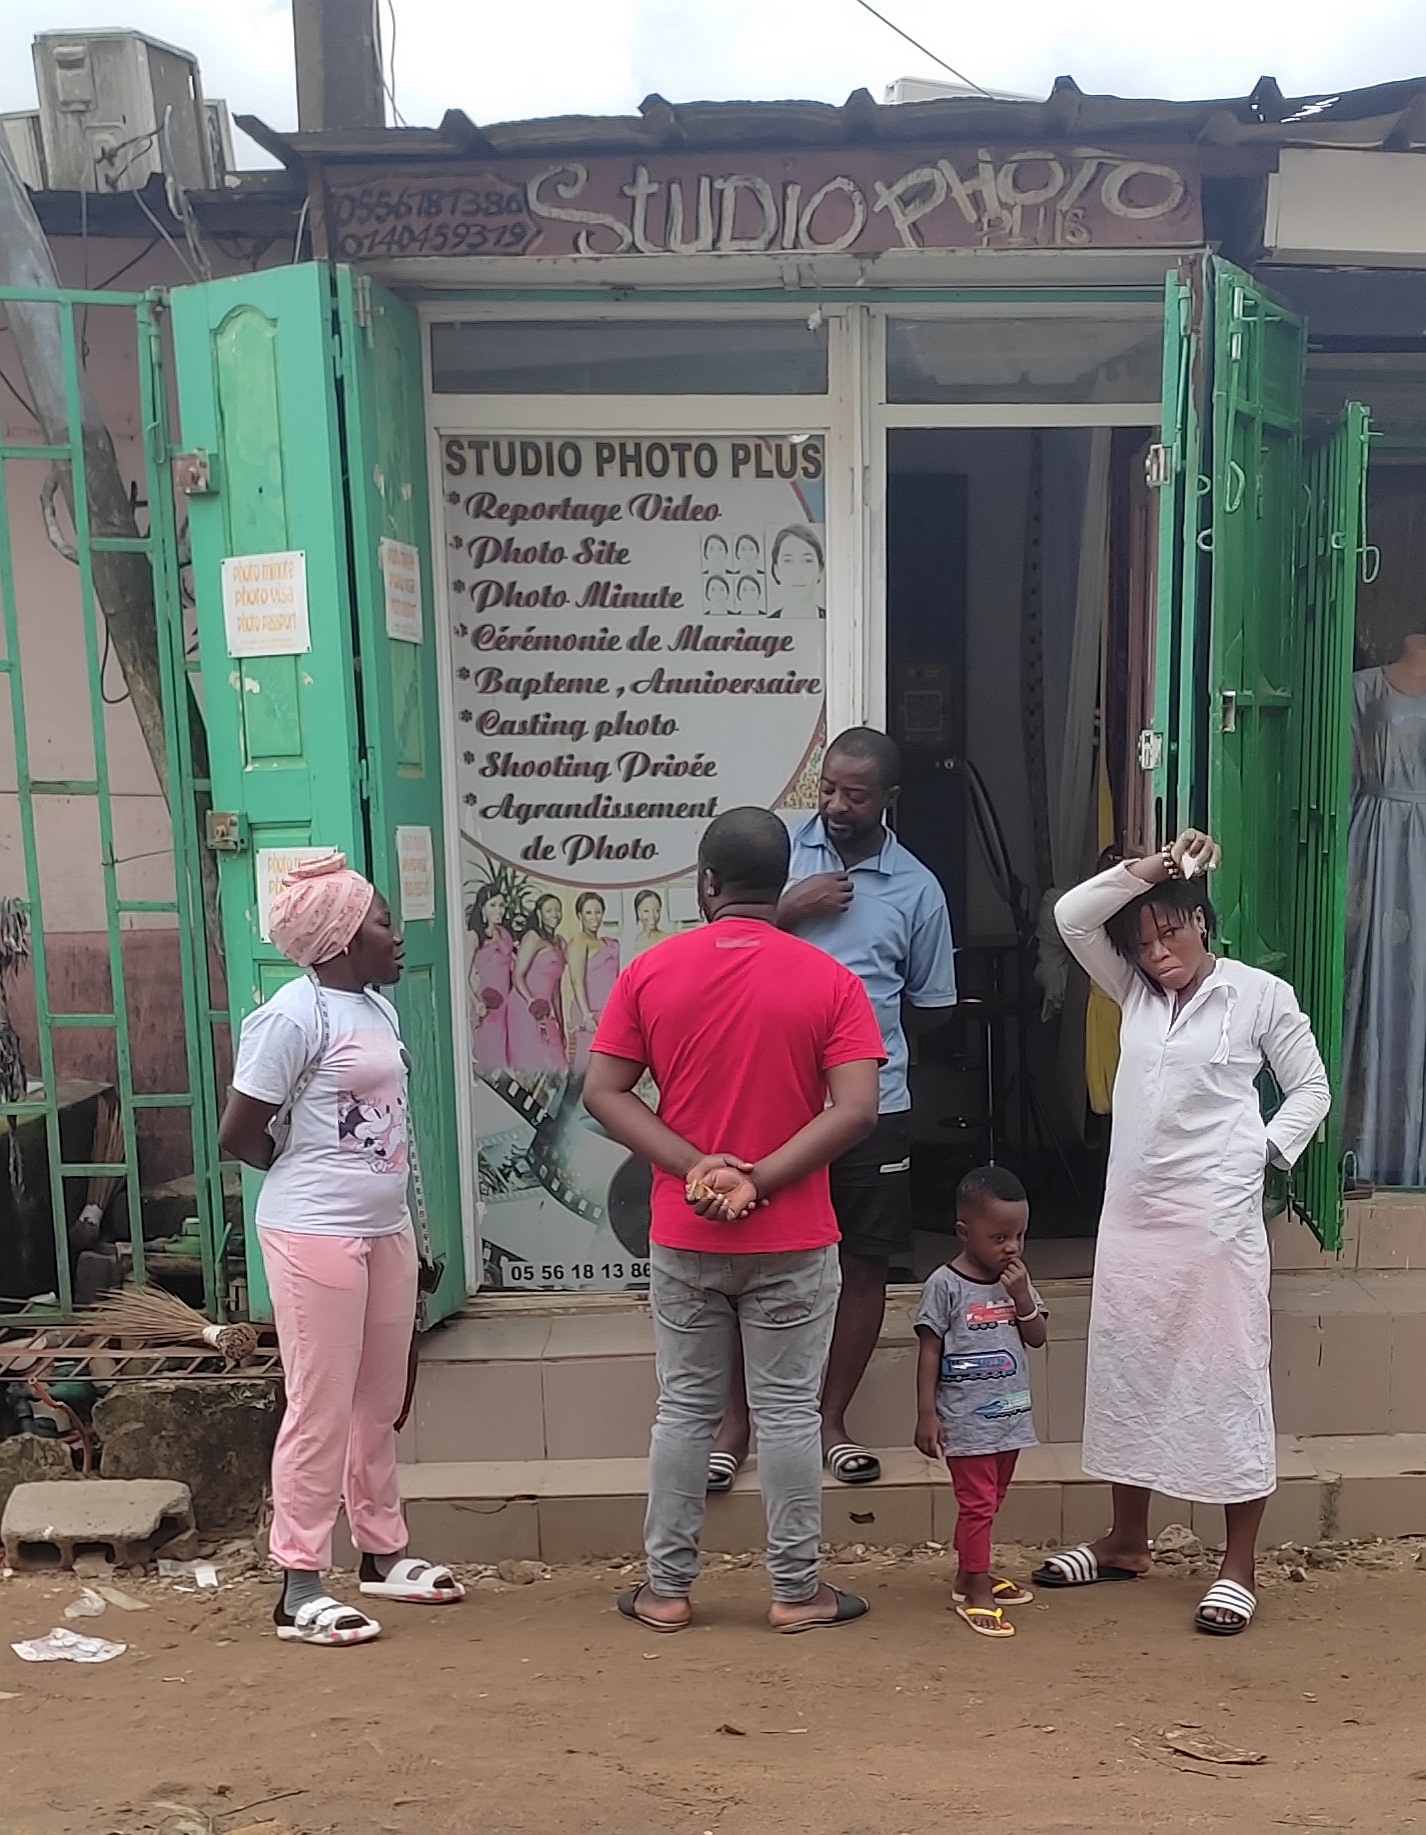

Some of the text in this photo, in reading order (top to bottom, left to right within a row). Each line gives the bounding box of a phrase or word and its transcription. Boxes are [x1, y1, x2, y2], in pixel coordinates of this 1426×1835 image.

[444, 439, 823, 479] STUDIO PHOTO PLUS
[465, 492, 722, 526] Reportage Video
[468, 535, 631, 569] Photo Site
[470, 579, 685, 613] Photo Minute
[471, 622, 795, 657] Cérémonie de Mariage
[474, 666, 610, 700] Bapteme
[475, 709, 679, 742] Casting photo
[478, 750, 718, 782] Shooting Privée
[479, 793, 720, 825] Agrandissement
[520, 833, 659, 866] de Photo
[511, 1266, 534, 1280] 05
[541, 1264, 564, 1280] 56
[571, 1264, 594, 1279] 18
[601, 1263, 624, 1278] 13
